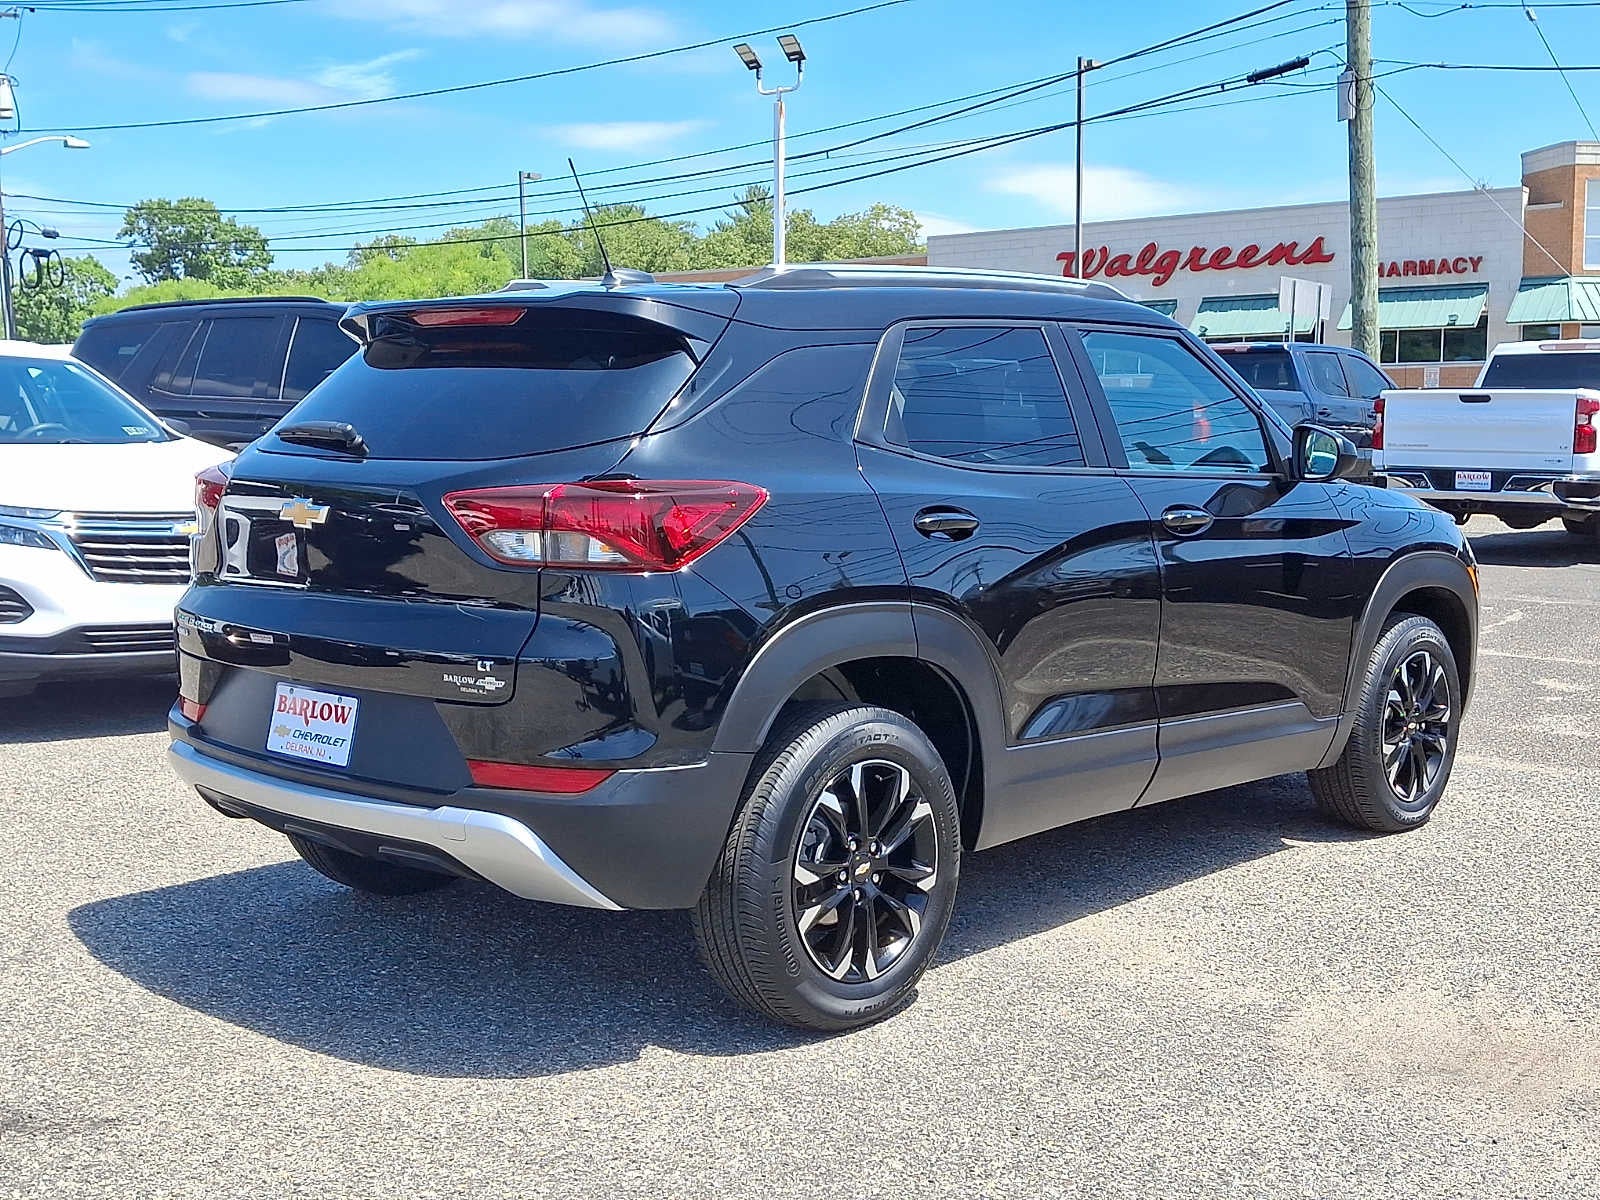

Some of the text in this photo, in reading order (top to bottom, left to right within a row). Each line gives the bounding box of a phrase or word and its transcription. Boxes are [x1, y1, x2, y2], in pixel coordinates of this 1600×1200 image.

[1056, 236, 1335, 287] Walgreens
[477, 660, 494, 671] LT
[443, 674, 475, 685] BARLOW
[276, 694, 352, 726] BARLOW
[292, 729, 348, 748] CHEVROLET
[315, 747, 326, 758] NJ
[771, 890, 801, 977] Continental
